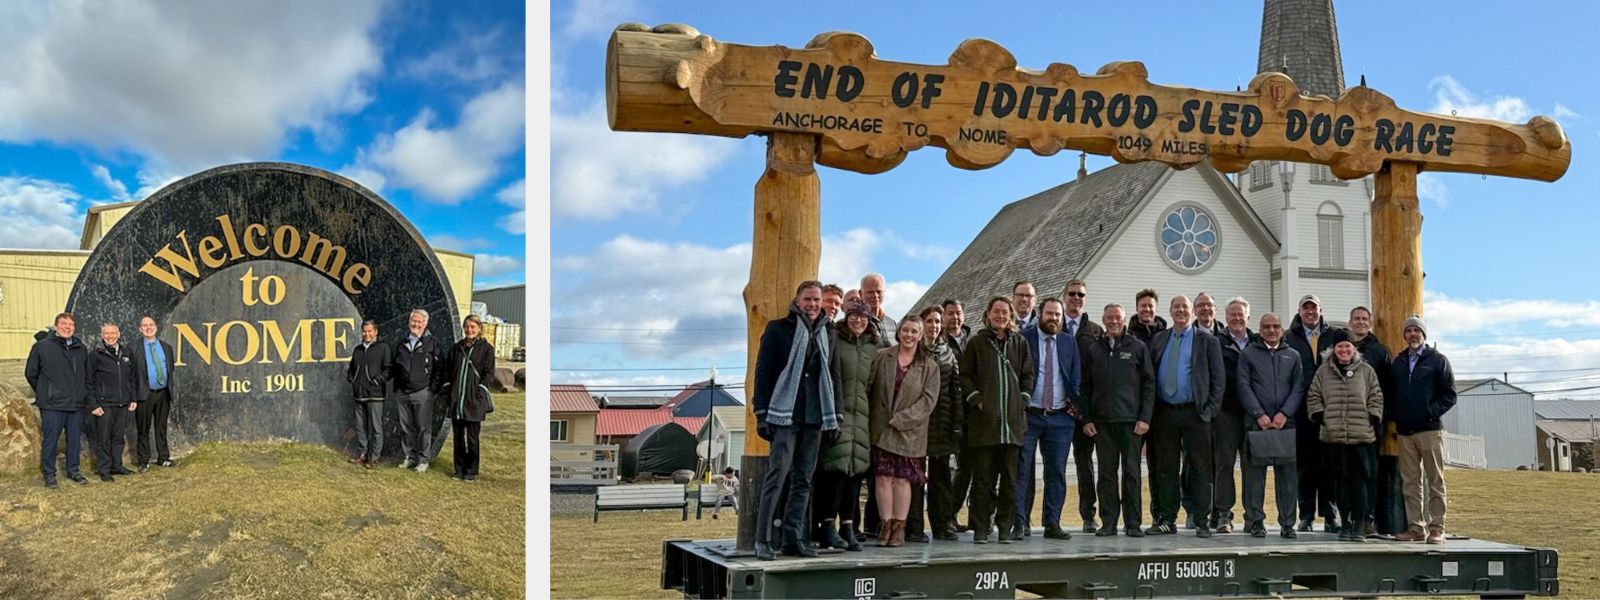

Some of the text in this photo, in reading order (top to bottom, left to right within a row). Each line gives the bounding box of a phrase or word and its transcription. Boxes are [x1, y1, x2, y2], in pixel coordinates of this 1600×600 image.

[774, 60, 1456, 157] END OF IDITAROD SLED DOG RACE
[772, 111, 1007, 146] ANCHORAGE TO NOME
[1117, 134, 1208, 156] 1049 MILES
[138, 213, 372, 295] Welcome
[239, 266, 286, 307] to
[173, 317, 355, 367] NOME
[220, 373, 305, 393] Inc 1901
[975, 571, 1009, 590] 29PA
[1137, 560, 1235, 579] AFFU 550035 3
